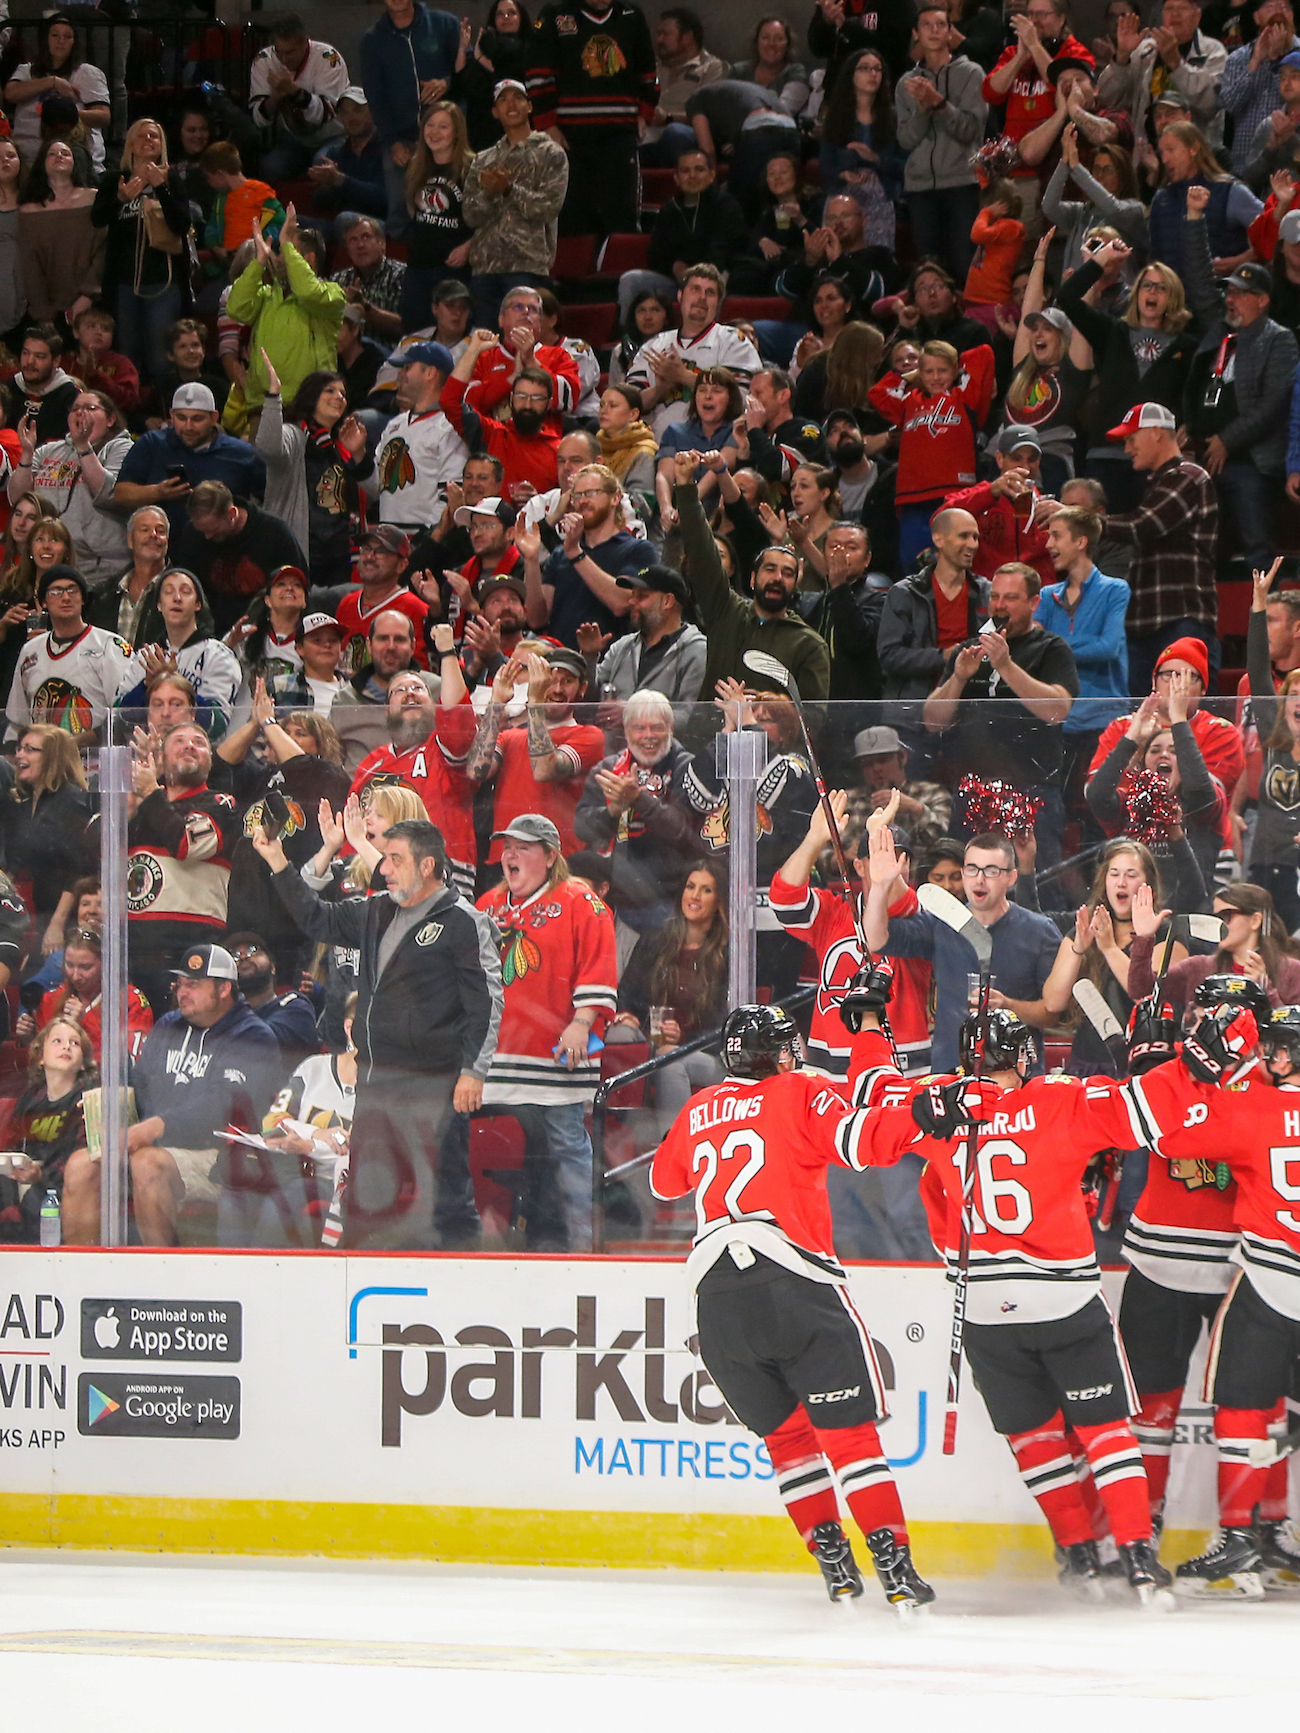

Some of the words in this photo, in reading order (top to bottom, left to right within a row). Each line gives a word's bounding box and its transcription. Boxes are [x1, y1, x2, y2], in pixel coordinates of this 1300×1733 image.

[438, 216, 459, 229] FANS
[195, 651, 205, 672] A
[411, 752, 428, 779] A
[727, 1036, 743, 1052] 22
[269, 1088, 294, 1114] 3
[689, 1094, 765, 1137] BELLOWS
[691, 1128, 778, 1240] 22
[951, 1139, 1034, 1236] 16
[130, 1308, 187, 1323] Download
[190, 1311, 204, 1323] on
[208, 1309, 227, 1323] the
[130, 1326, 171, 1356] App
[174, 1327, 229, 1351] Store
[126, 1384, 158, 1394] ANDROID
[158, 1385, 172, 1394] APP
[173, 1385, 184, 1394] ON
[808, 1384, 861, 1405] CCM
[1066, 1383, 1114, 1401] CCM
[125, 1395, 192, 1425] Google
[198, 1398, 233, 1425] play
[28, 1429, 66, 1450] APP
